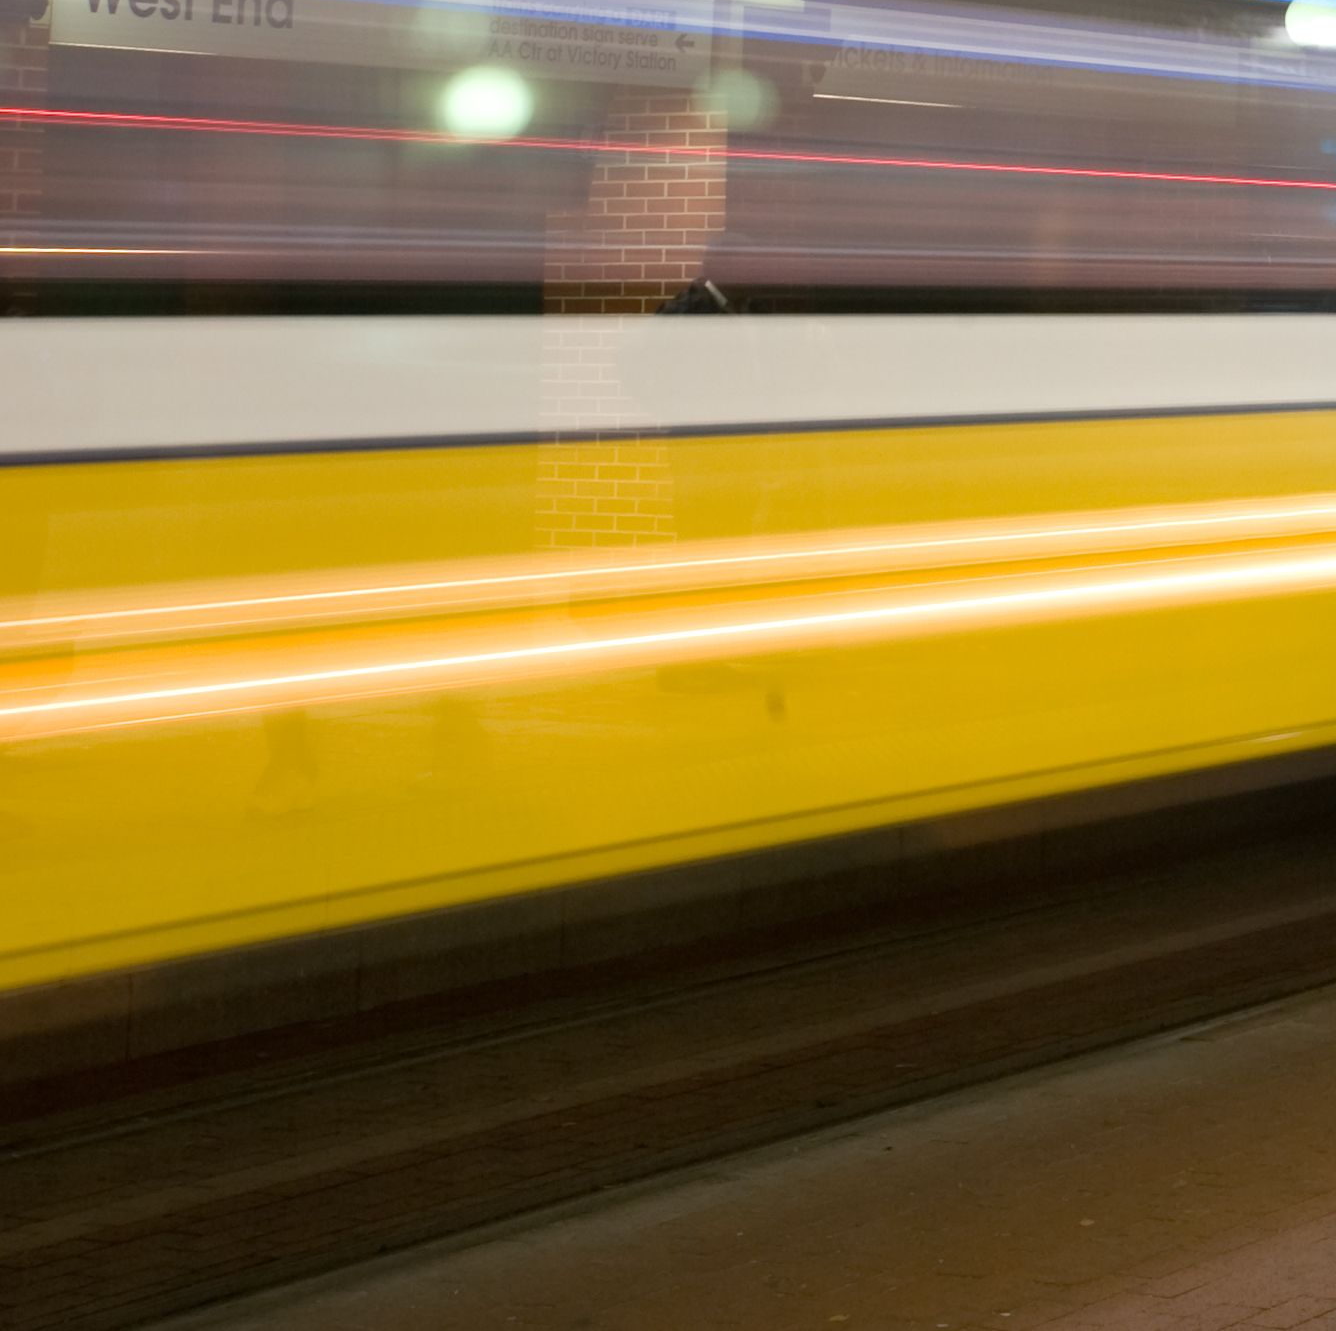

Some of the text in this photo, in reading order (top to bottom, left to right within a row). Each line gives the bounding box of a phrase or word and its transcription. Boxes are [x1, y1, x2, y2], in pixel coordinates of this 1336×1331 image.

[490, 17, 658, 48] destination sign serve
[489, 39, 677, 71] AA Ctr at Victory Station
